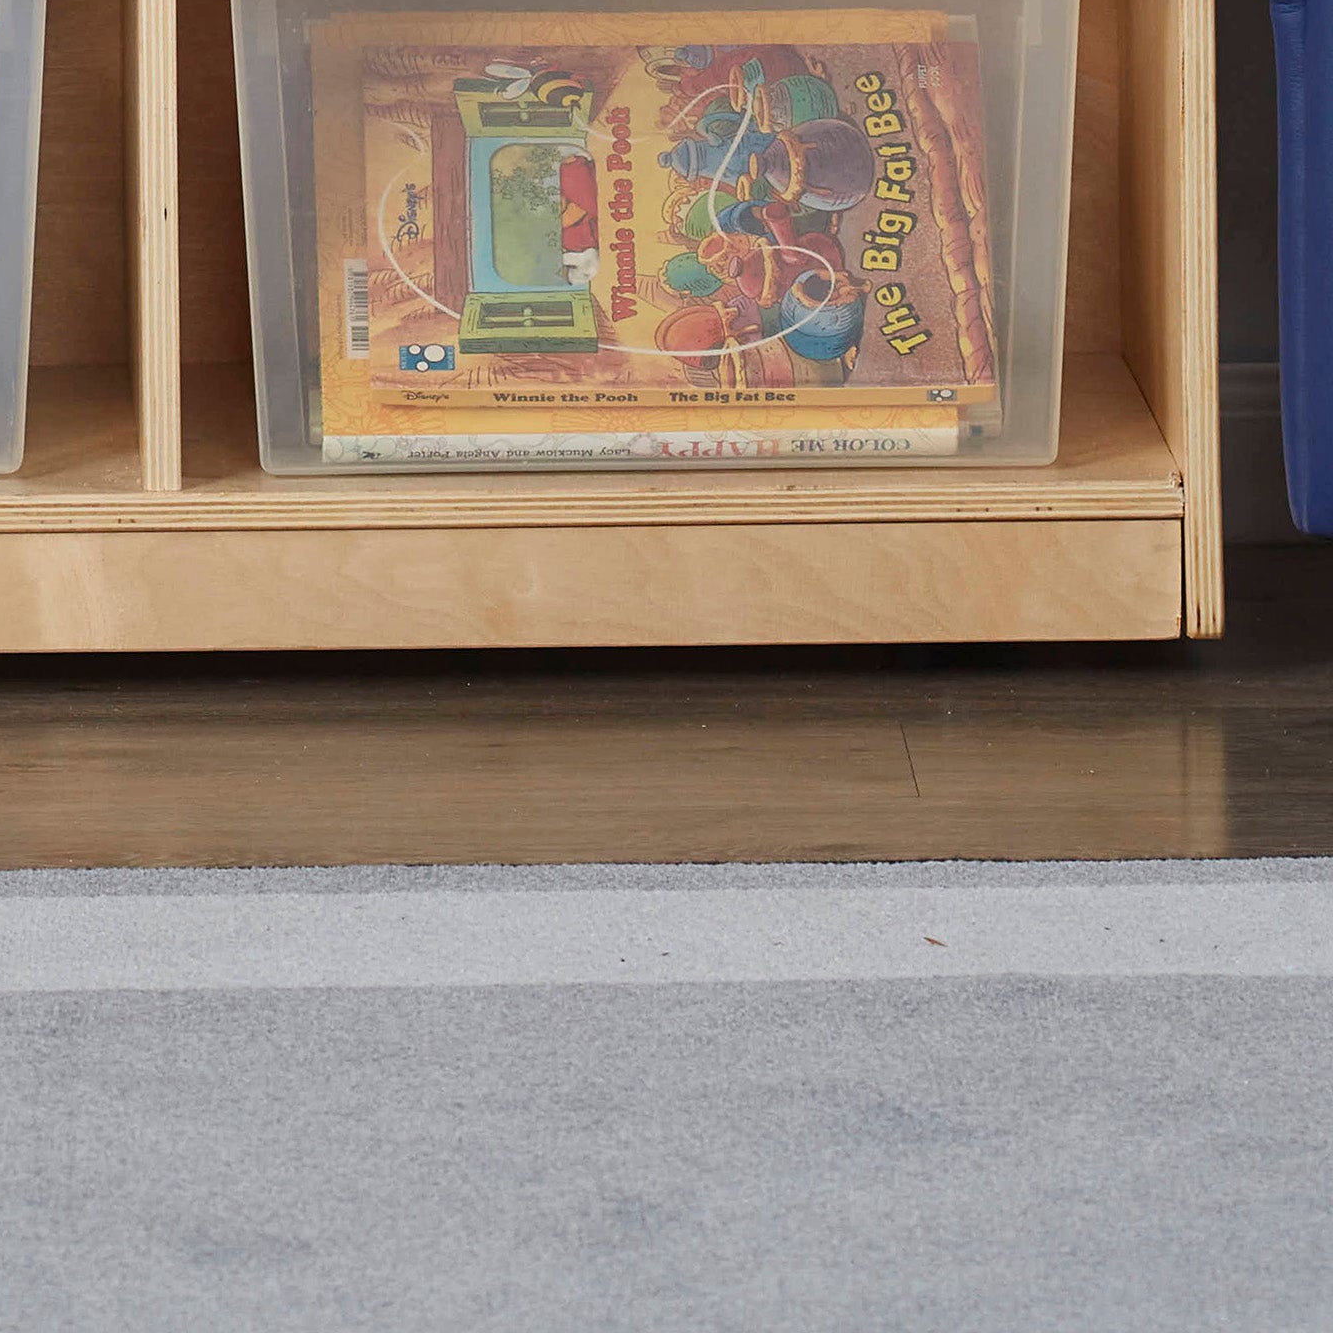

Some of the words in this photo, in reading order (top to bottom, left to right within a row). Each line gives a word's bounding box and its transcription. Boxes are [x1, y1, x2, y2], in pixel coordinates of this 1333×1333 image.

[853, 71, 907, 139] Bee
[606, 106, 633, 173] Pooh
[874, 141, 916, 204] Fat
[608, 178, 635, 223] the
[396, 182, 425, 243] Disney's
[860, 208, 917, 272] Big
[609, 227, 638, 323] Winnie
[874, 282, 932, 357] The
[402, 391, 450, 403] Disney's
[493, 393, 556, 402] Winnie
[560, 393, 590, 402] the
[594, 393, 638, 402] Pooh
[669, 392, 699, 402] The
[704, 393, 731, 404] Big
[735, 393, 761, 402] Fat
[764, 393, 796, 402] Bee
[407, 448, 450, 459] Porter
[455, 448, 502, 459] Angela
[506, 448, 530, 458] and
[535, 448, 594, 457] Mucklow
[600, 447, 631, 457] Lacy
[658, 439, 781, 458] HAPPY
[790, 439, 827, 454] ME
[833, 439, 912, 452] COLOR
